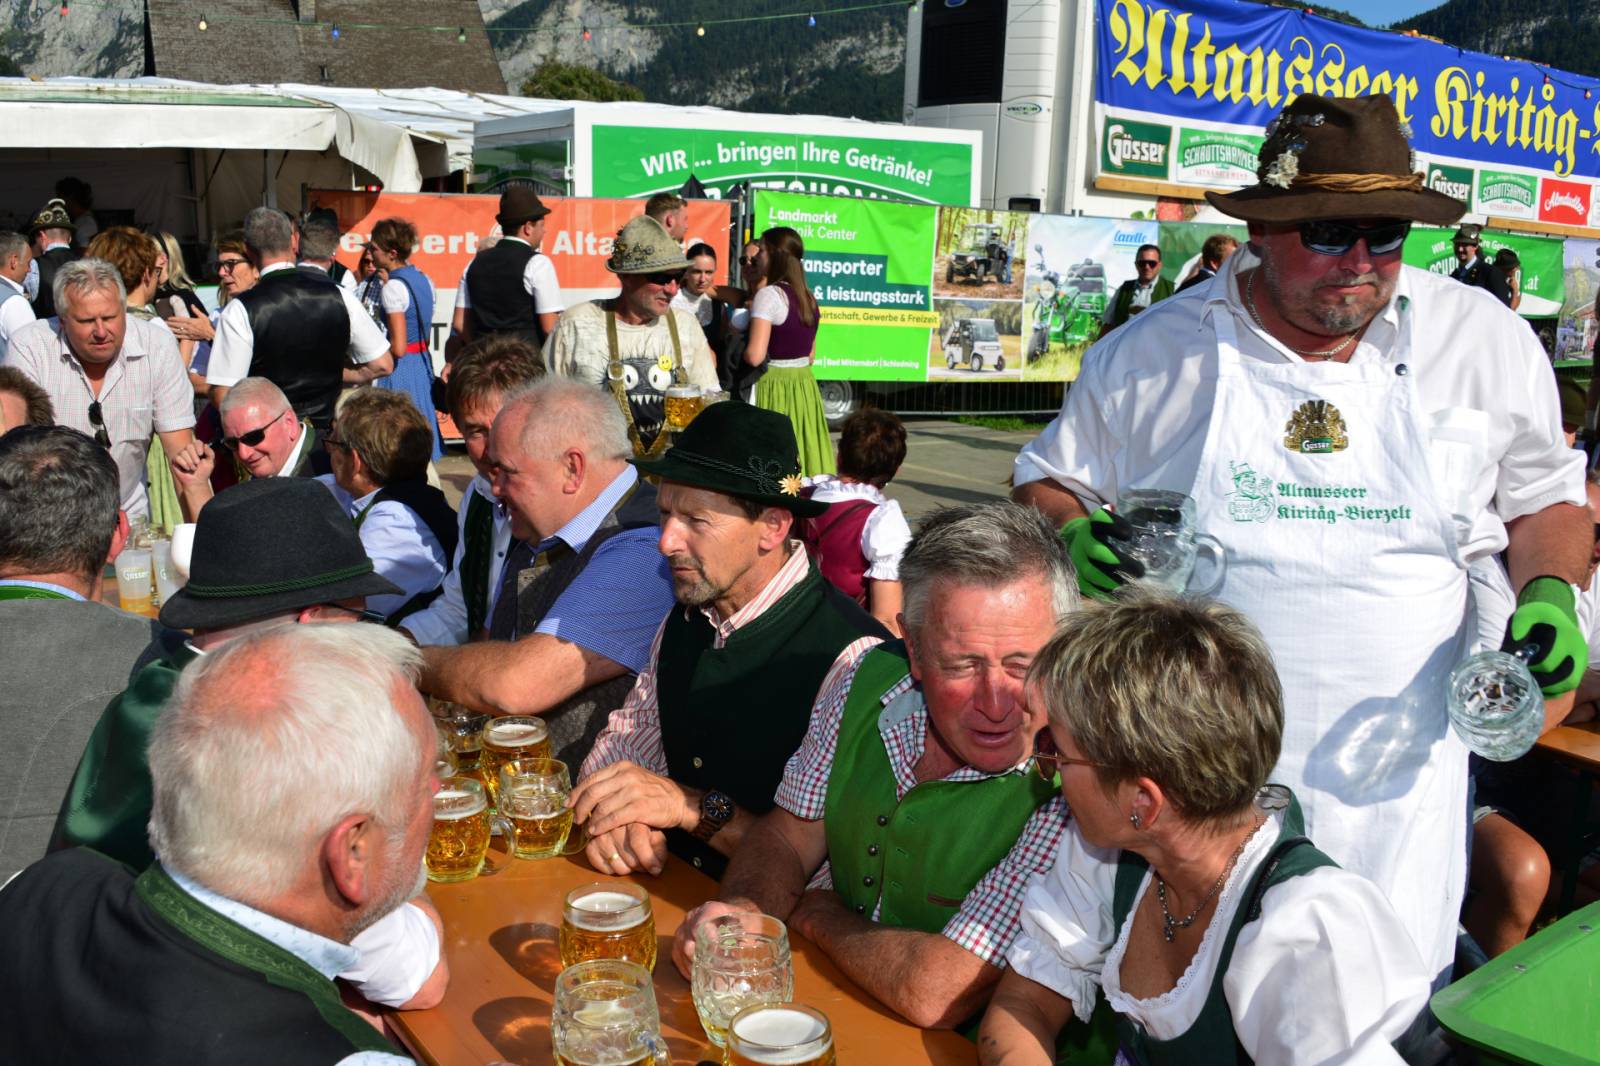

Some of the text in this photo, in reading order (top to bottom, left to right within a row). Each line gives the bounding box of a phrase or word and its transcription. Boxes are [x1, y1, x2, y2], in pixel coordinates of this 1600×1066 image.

[1431, 66, 1600, 177] Kiritåg-
[1107, 124, 1167, 169] Gösser
[641, 149, 688, 176] WIR
[717, 142, 797, 168] bringen
[802, 143, 840, 165] Ihre
[845, 147, 933, 187] Getränke!
[769, 207, 837, 224] Landmarkt
[339, 231, 479, 255] eert
[817, 226, 857, 241] Center
[801, 258, 883, 277] ansporter
[1524, 275, 1540, 291] .at
[814, 286, 924, 306] & leistungsstark
[863, 313, 898, 322] Gewerbe
[907, 314, 938, 324] Freizeit
[1277, 482, 1367, 499] Altausseer
[1277, 504, 1412, 524] Kiritåg-Bierzelt
